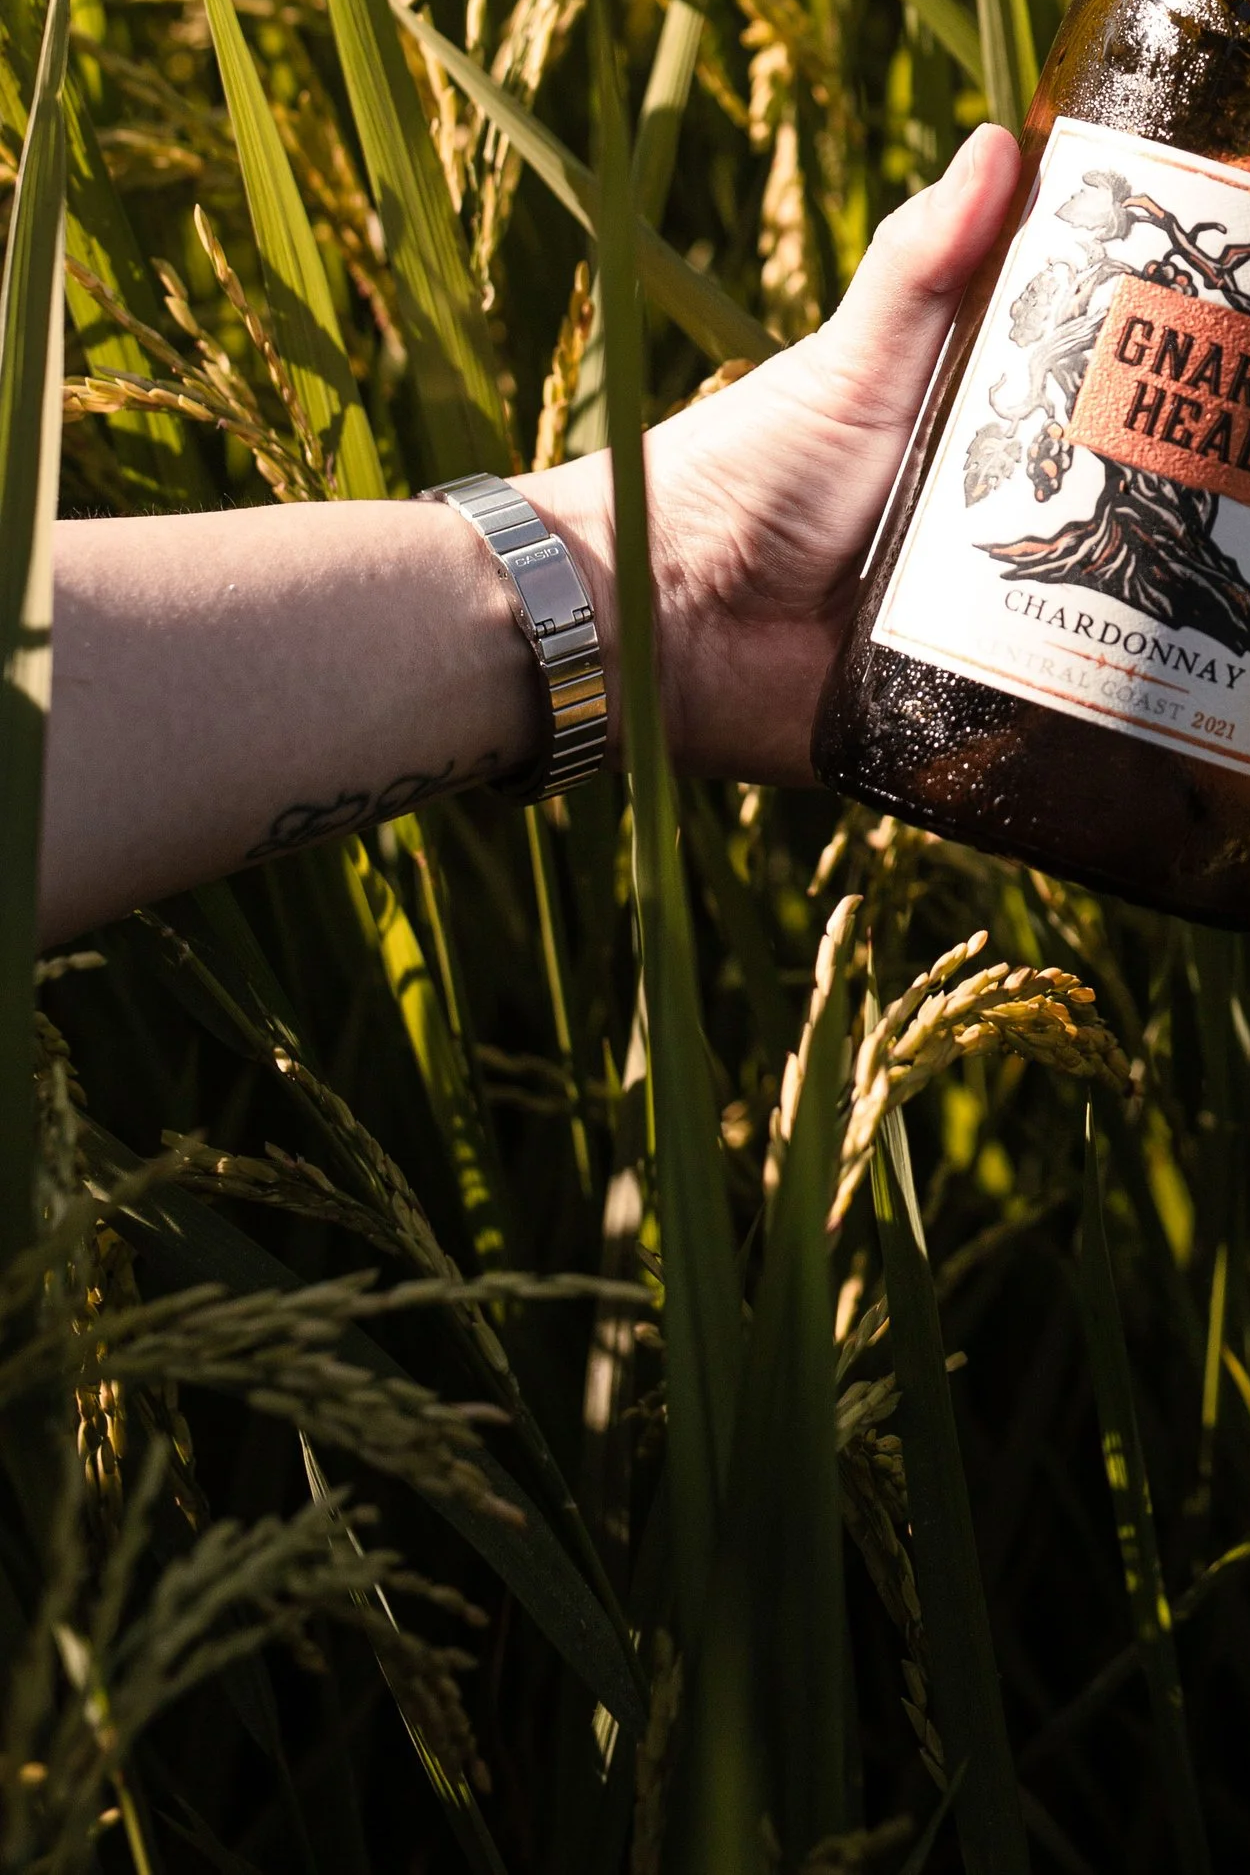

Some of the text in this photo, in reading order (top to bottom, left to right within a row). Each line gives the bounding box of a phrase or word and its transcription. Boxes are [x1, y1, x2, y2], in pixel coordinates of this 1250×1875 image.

[514, 547, 559, 567] CASIO
[1004, 589, 1246, 690] CHARDONNAY
[1101, 679, 1185, 720] COAST
[1191, 711, 1236, 740] 2021
